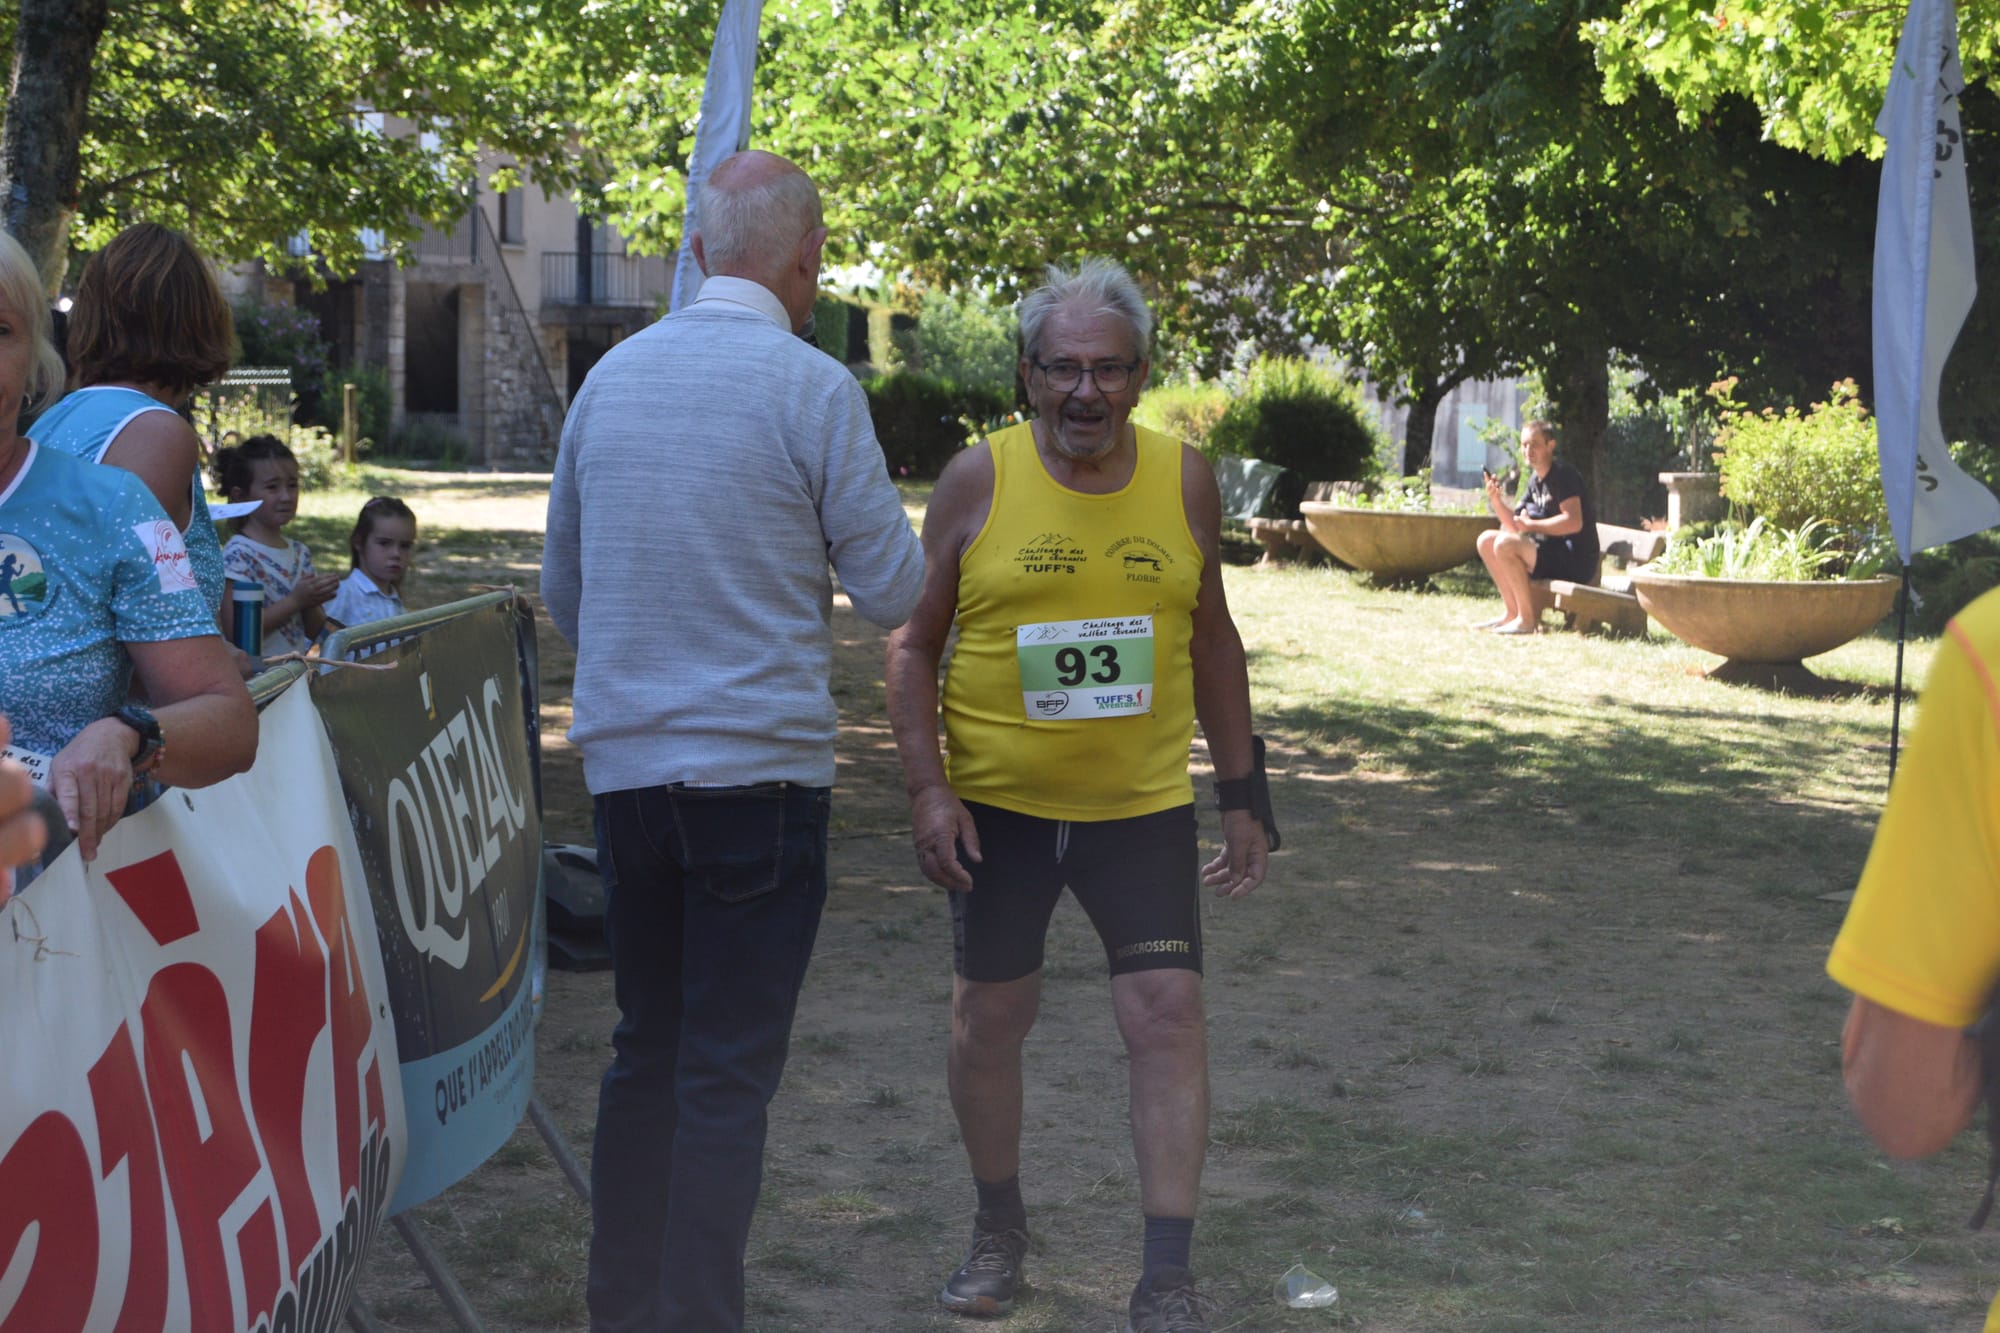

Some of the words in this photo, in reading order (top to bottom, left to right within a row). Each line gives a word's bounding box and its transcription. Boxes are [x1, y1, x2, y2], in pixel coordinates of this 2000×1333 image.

[1019, 547, 1064, 556] Challenge
[1023, 564, 1076, 574] TUFF'S
[1081, 620, 1124, 630] Challenge
[1129, 618, 1143, 627] des
[1055, 644, 1121, 687] 93
[1036, 699, 1065, 709] BFP
[1093, 694, 1134, 705] TUFF'S
[435, 1065, 466, 1126] QUE
